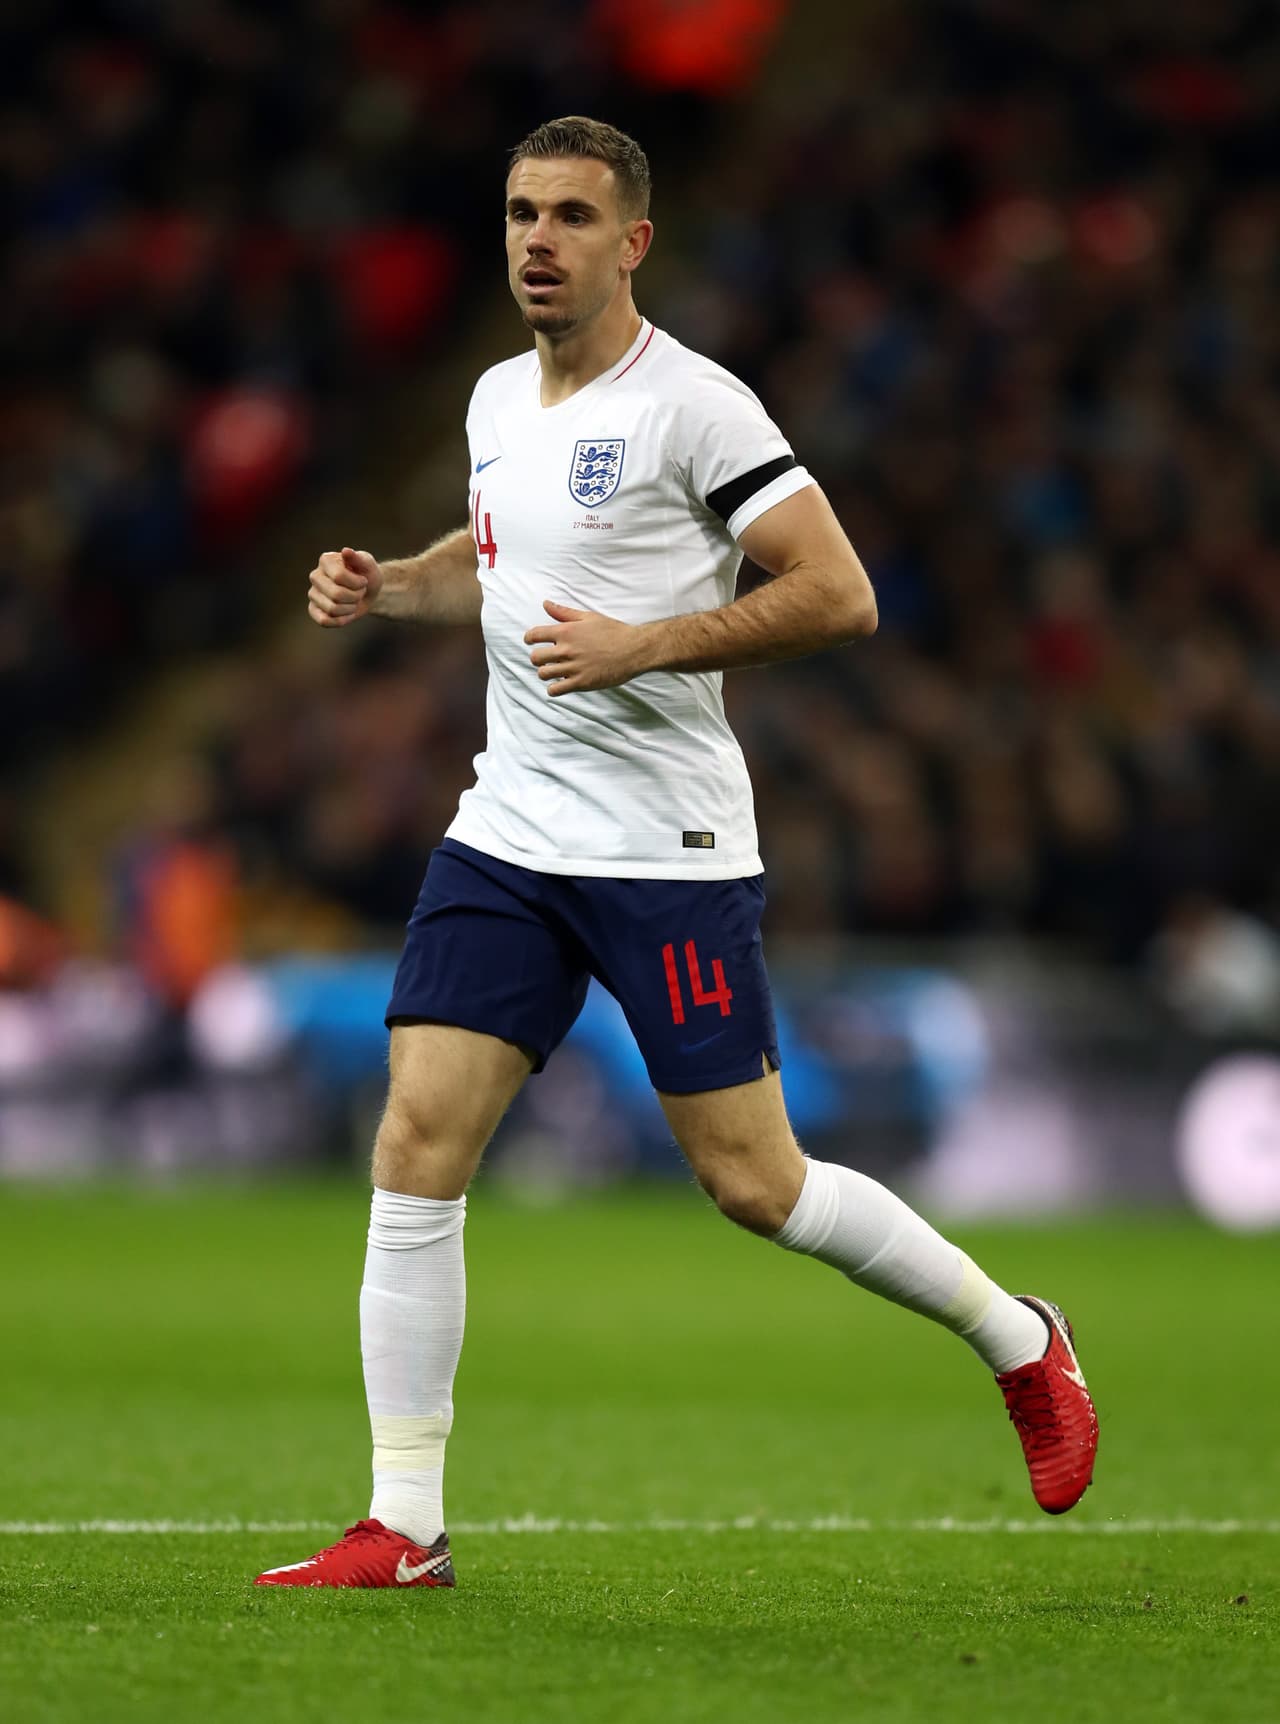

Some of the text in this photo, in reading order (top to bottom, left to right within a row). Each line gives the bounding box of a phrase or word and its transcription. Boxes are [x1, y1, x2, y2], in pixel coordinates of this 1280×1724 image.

[472, 489, 498, 569] 4
[573, 521, 580, 529] 27
[581, 522, 600, 530] MARCH
[662, 938, 733, 1024] 14
